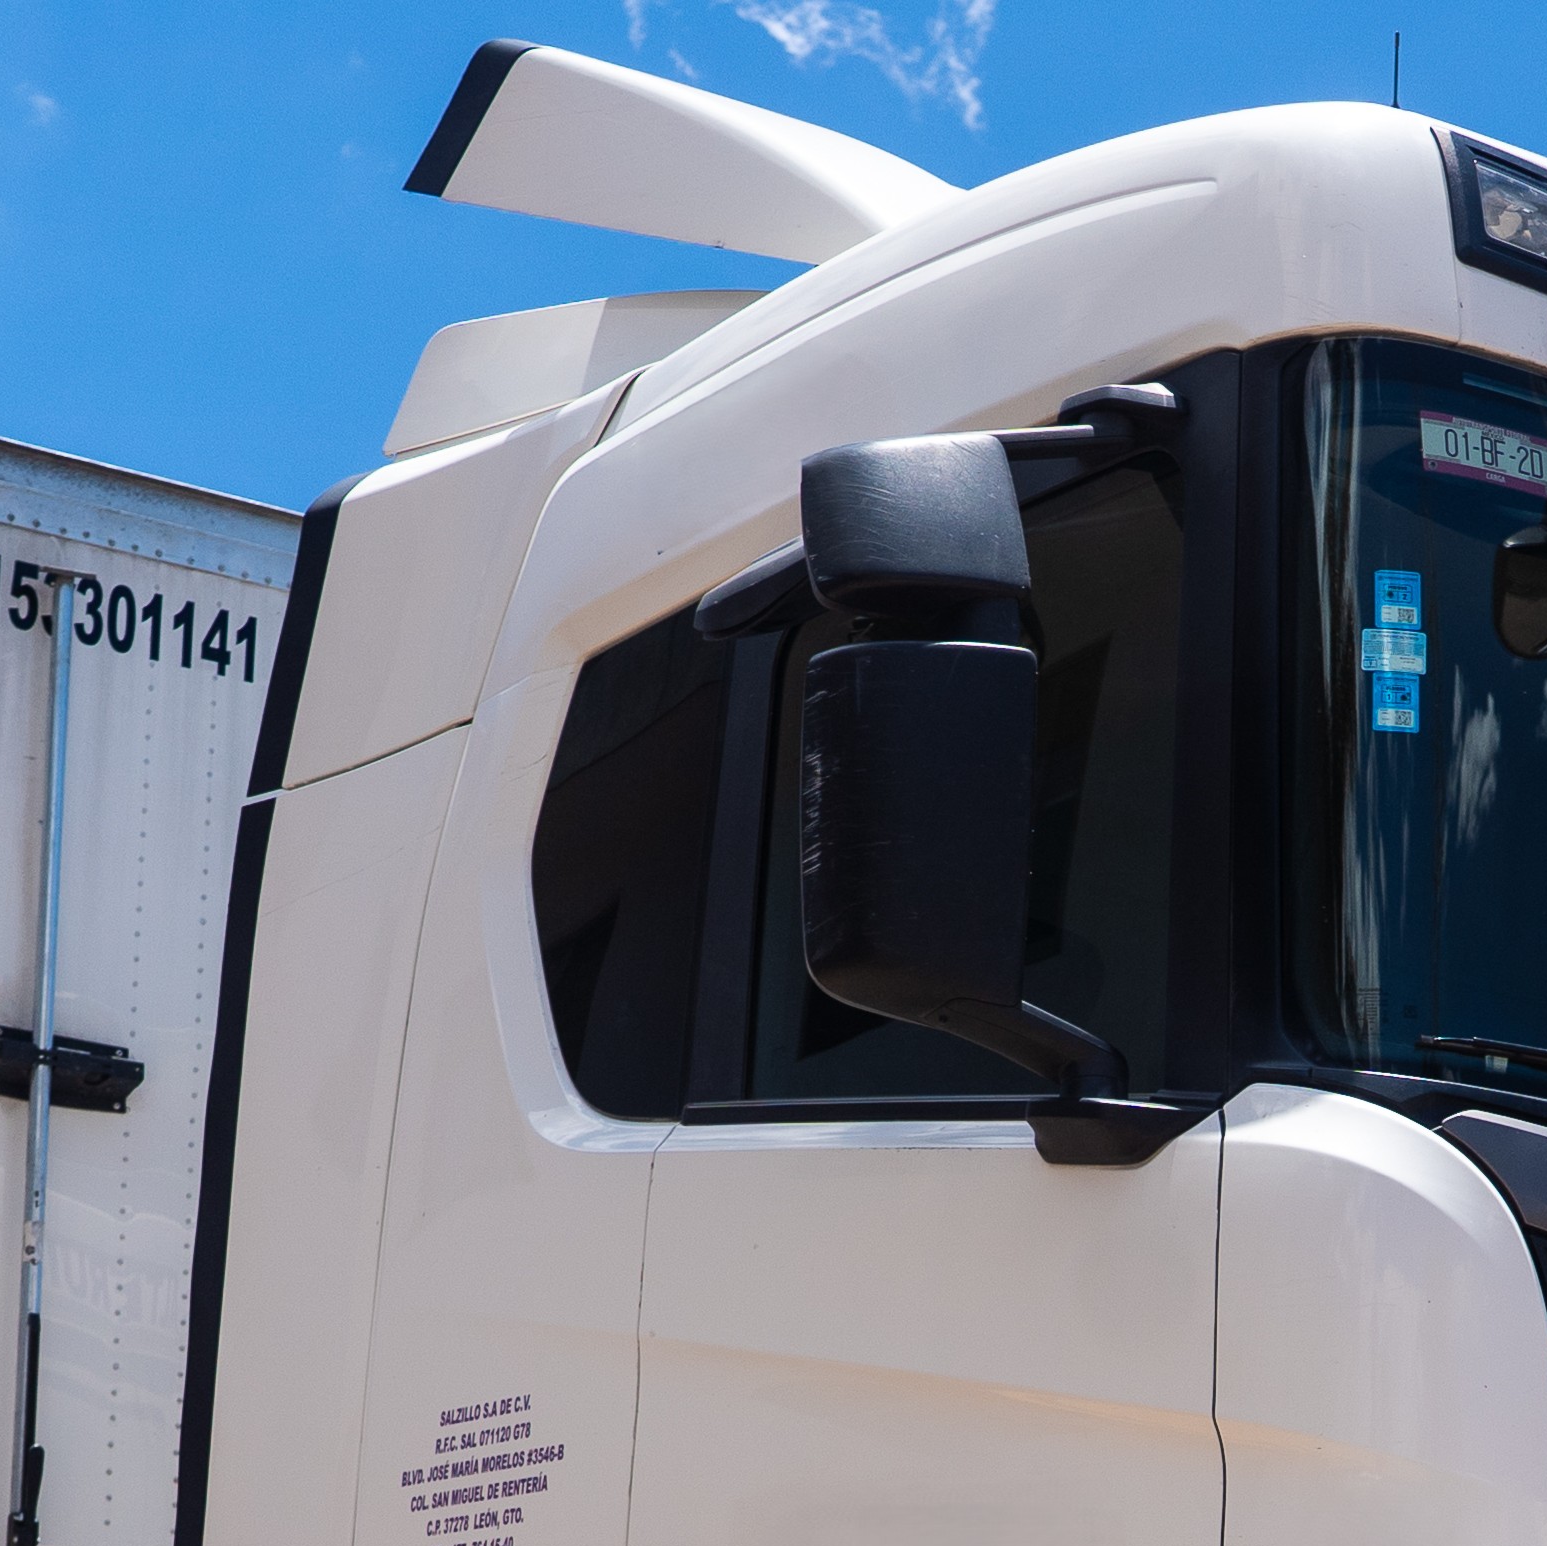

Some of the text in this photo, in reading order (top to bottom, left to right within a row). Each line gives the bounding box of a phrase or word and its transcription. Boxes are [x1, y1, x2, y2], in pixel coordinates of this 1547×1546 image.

[1444, 428, 1544, 479] 01-BF-2D
[440, 1404, 481, 1427] SALZILLO
[499, 1398, 512, 1415] DE
[514, 1394, 531, 1412] C.V.
[435, 1422, 531, 1454] R.F.C. SAL 071120 G78
[401, 1444, 565, 1487] BLVD. JOSÉ MARÍA MORELOS #3546-B
[410, 1472, 548, 1512] COL. SAN MIGUEL DE RENTERÍA
[426, 1507, 524, 1536] C.P. 37278 LEÓN, GTO.
